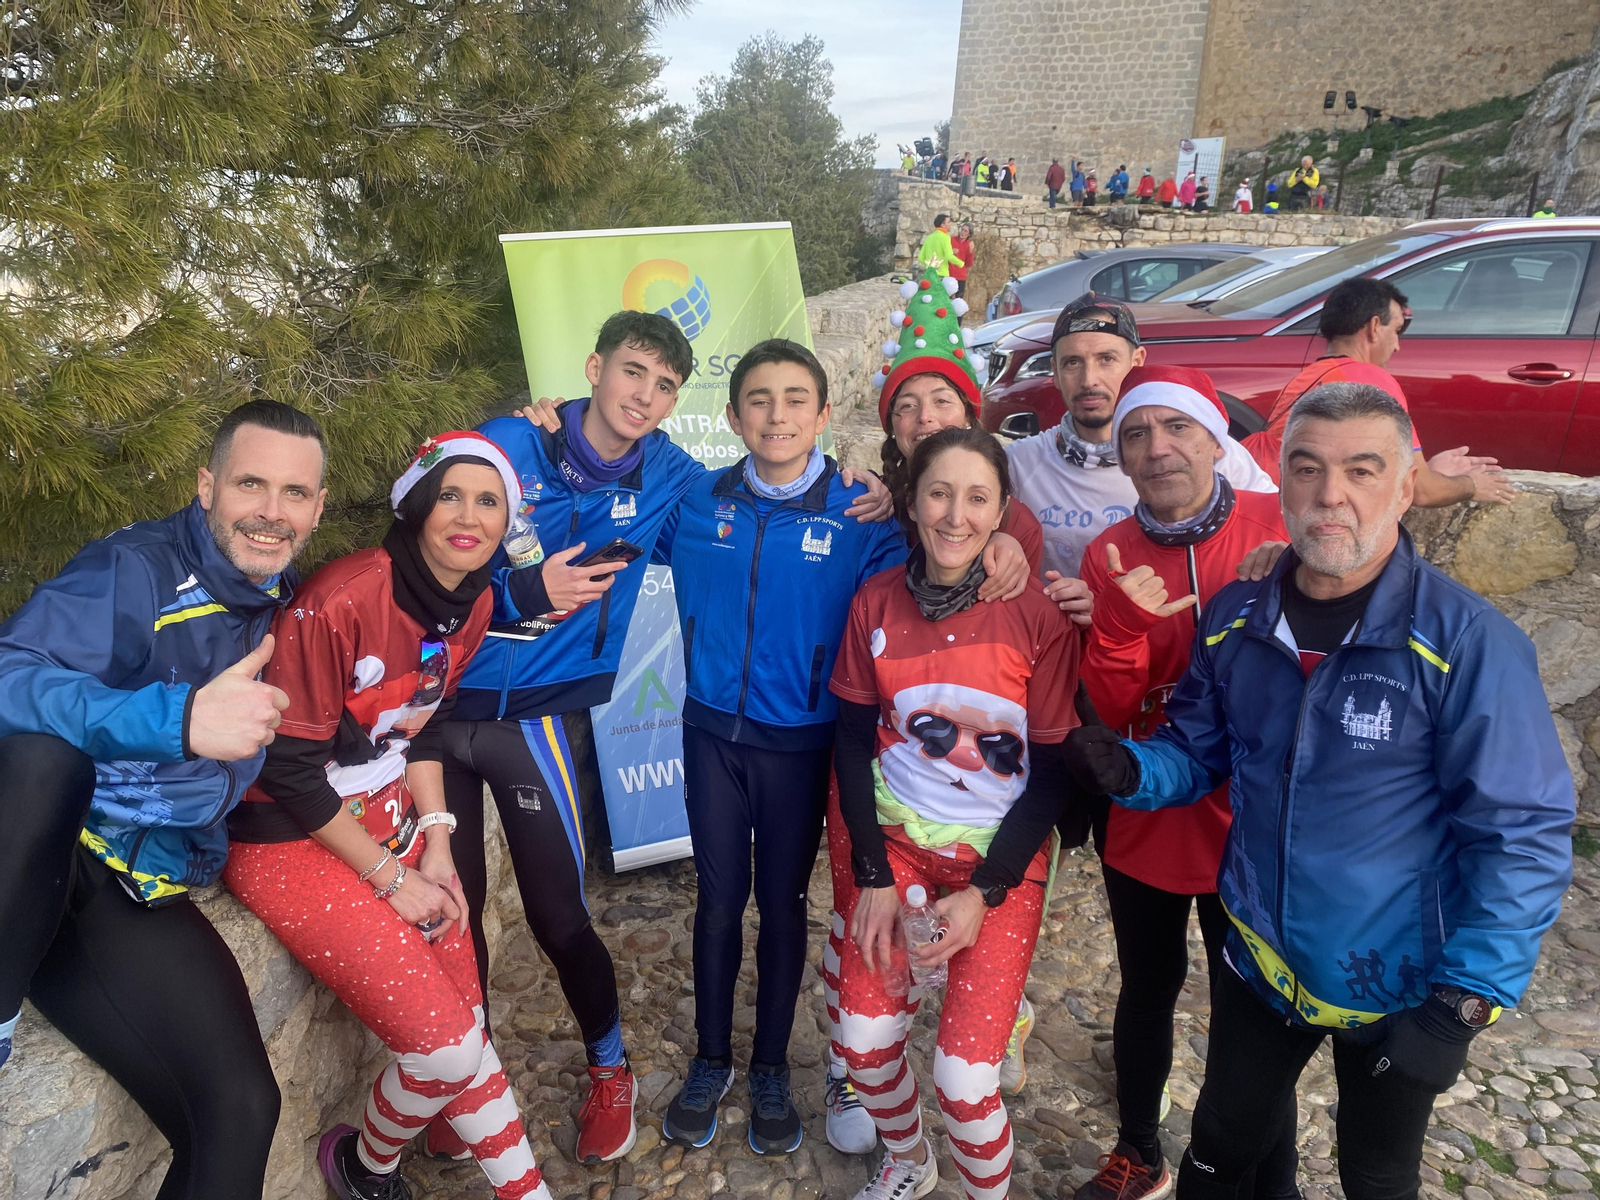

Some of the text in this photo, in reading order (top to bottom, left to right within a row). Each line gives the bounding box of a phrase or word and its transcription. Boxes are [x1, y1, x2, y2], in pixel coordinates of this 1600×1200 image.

[657, 414, 731, 434] NTRA
[822, 518, 844, 530] SPORTS
[1039, 504, 1093, 529] Leo
[804, 554, 823, 562] JAÉN
[638, 572, 675, 596] 54
[1343, 673, 1407, 691] C.D. LPP SPORTS
[610, 723, 641, 736] Junta
[643, 718, 656, 730] de
[1352, 741, 1376, 751] JAÉN
